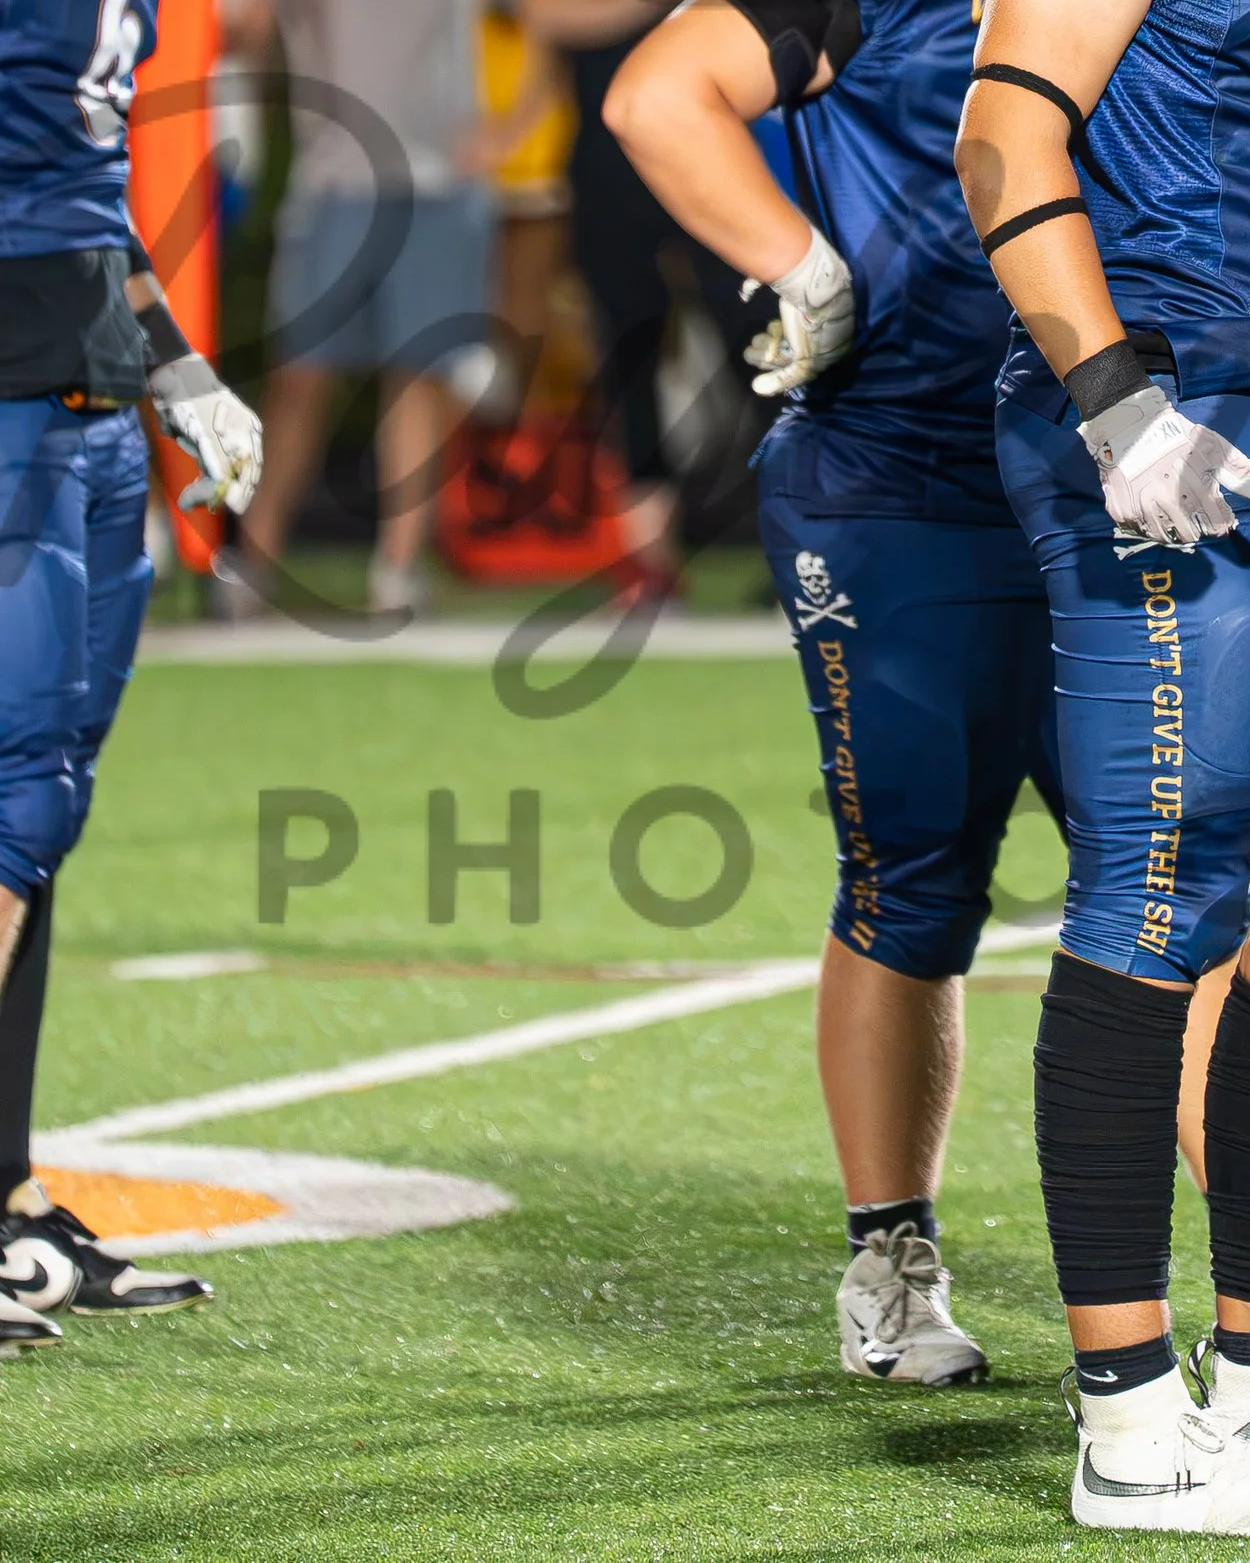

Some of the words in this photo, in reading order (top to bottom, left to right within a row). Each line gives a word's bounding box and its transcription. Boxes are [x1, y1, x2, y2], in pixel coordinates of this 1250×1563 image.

[1142, 569, 1183, 676] DON'T
[817, 639, 851, 741] DON'T
[835, 745, 863, 824] GIVE
[1152, 684, 1183, 766] GIVE
[1151, 775, 1183, 821] UP
[1146, 829, 1181, 895] THE
